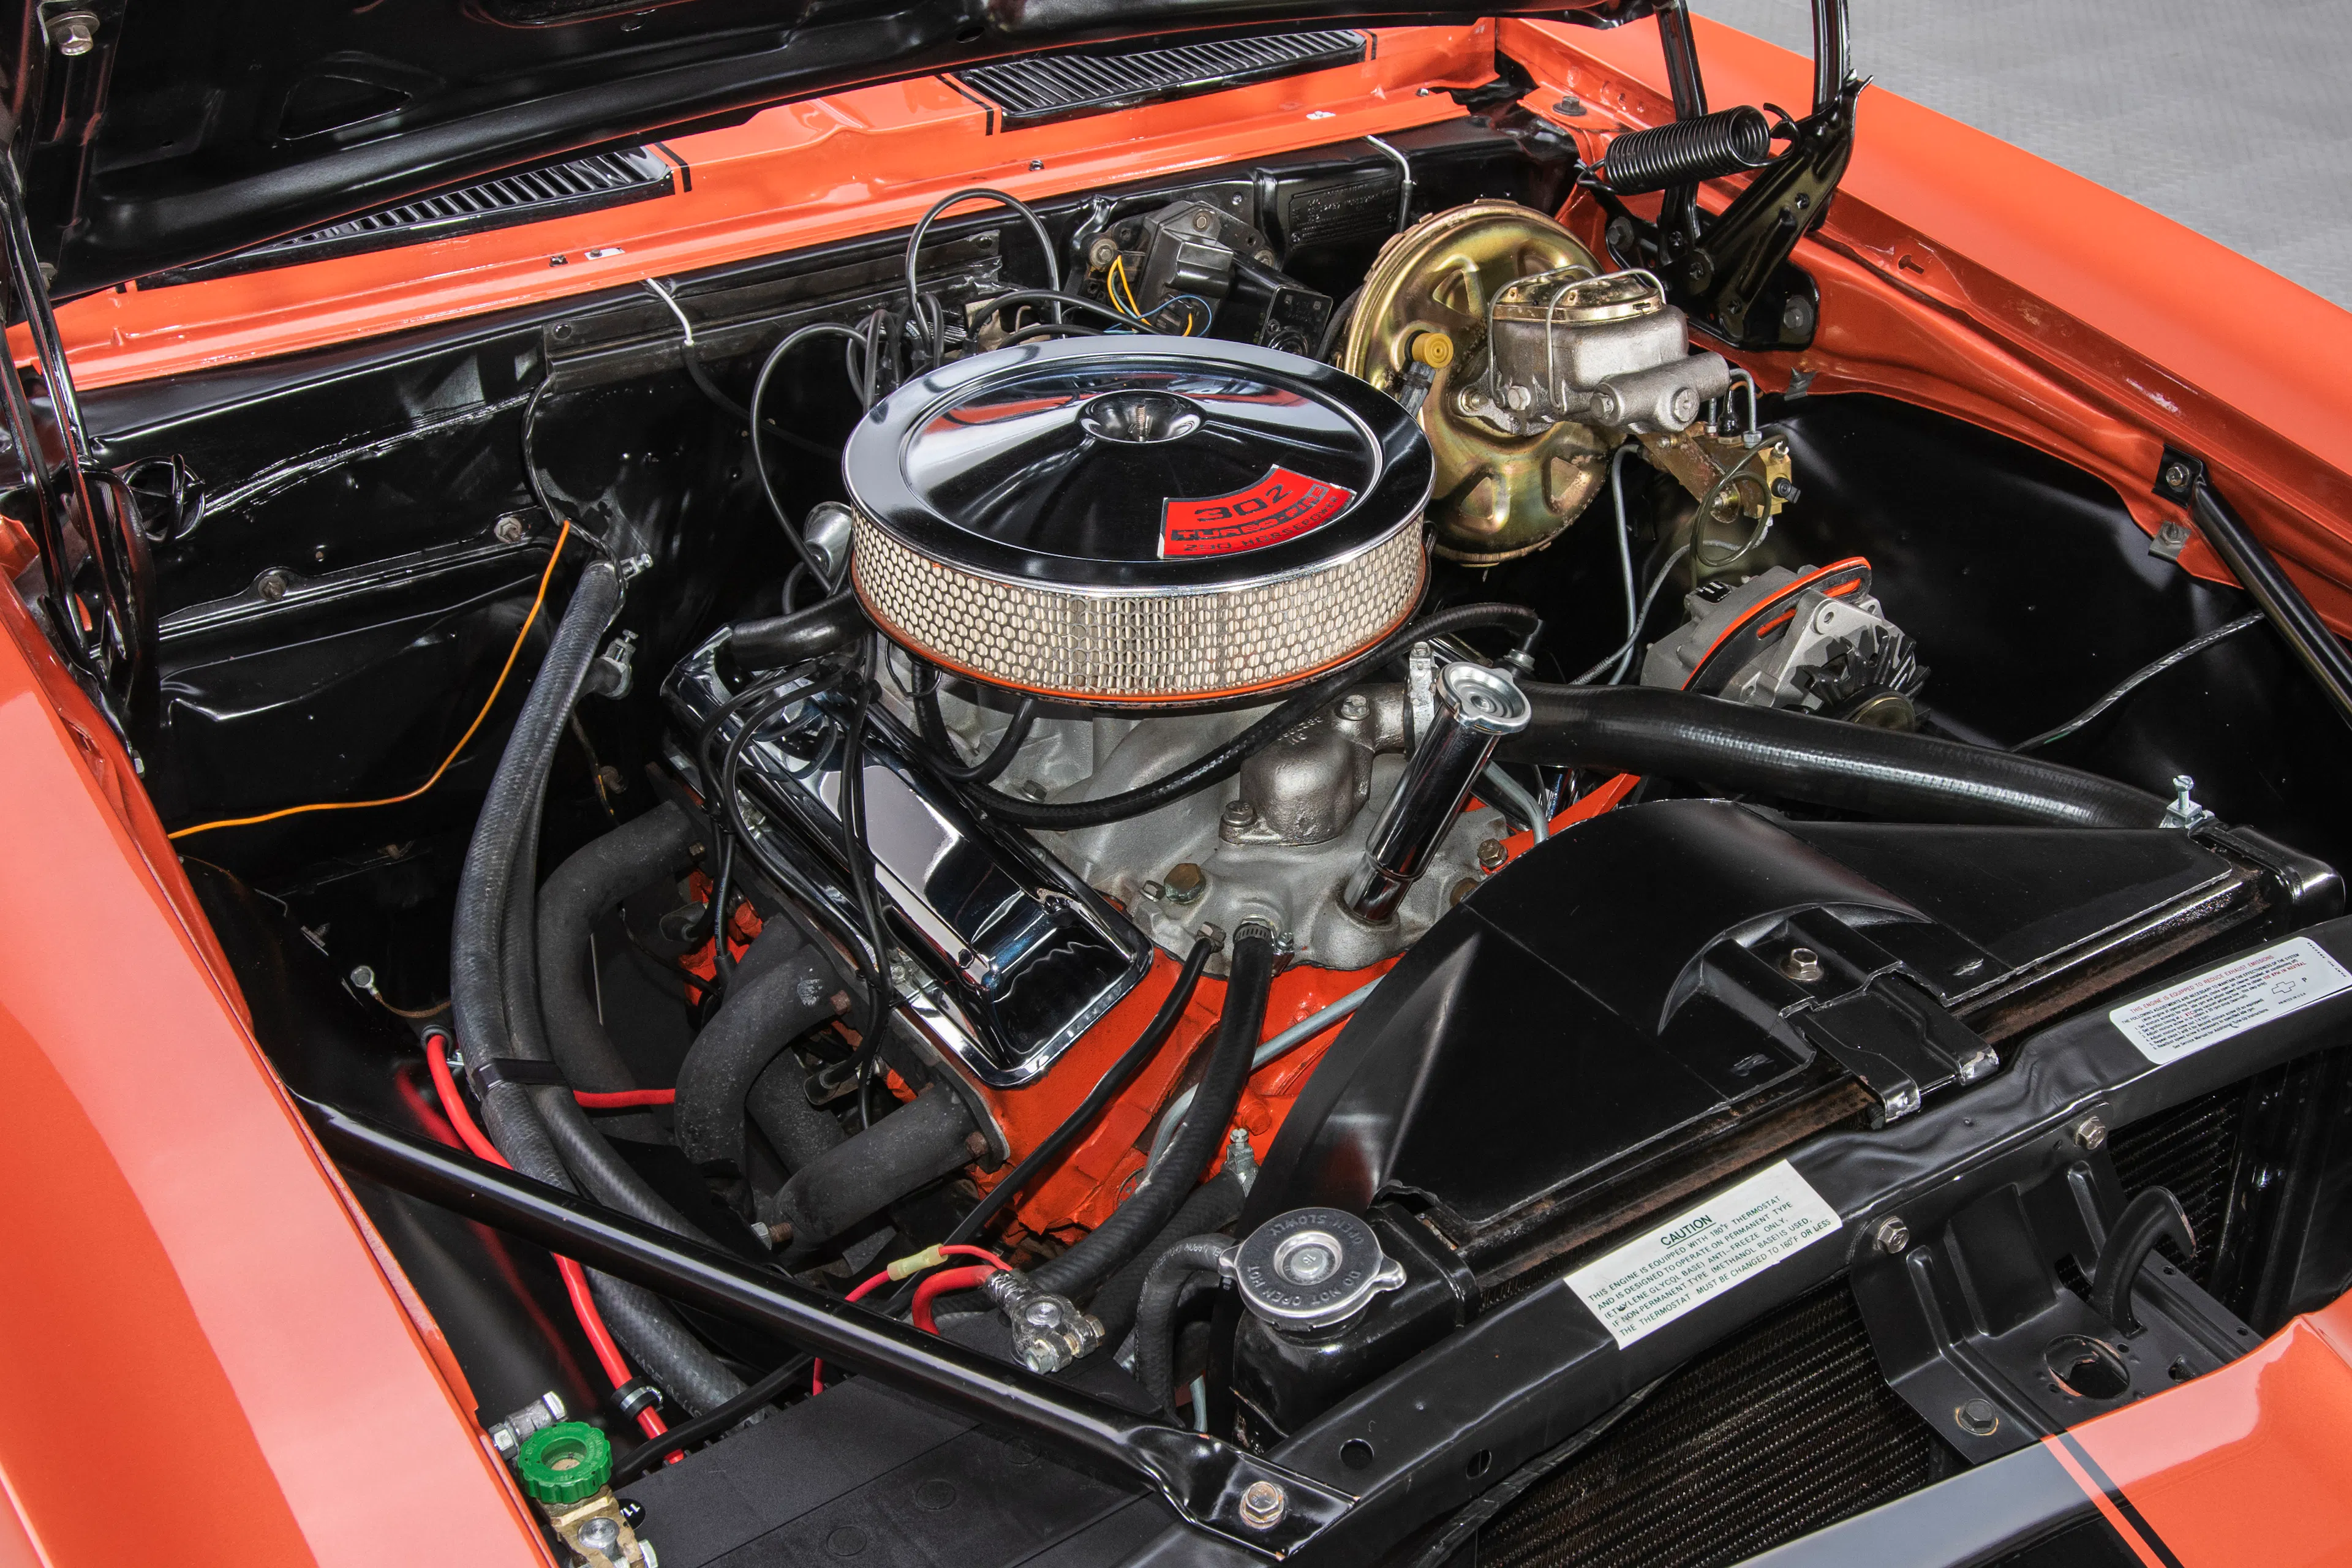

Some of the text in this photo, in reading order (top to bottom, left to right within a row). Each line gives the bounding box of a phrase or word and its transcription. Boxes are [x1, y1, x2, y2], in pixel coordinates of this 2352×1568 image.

[1183, 496, 1339, 551] 290 HORSEPOWER
[1194, 484, 1294, 522] 302
[2143, 998, 2163, 1008] ENGINE
[2169, 985, 2195, 998] EQUIPPED
[2203, 973, 2225, 984] REDUCE
[2223, 965, 2247, 976] EXHAUST
[2247, 955, 2274, 967] EMISSIONS
[2286, 962, 2307, 971] NEUTRAL
[2130, 1009, 2154, 1021] FOLLOWING
[2154, 999, 2182, 1012] ADJUSTMENTS
[2189, 987, 2211, 998] NECESSARY
[2217, 978, 2236, 987] MAINTAIN
[2242, 963, 2272, 977] EFFECTIVENESS
[1268, 1215, 1365, 1245] OPEN SLOWLY
[1588, 1288, 1608, 1301] THIS
[1608, 1271, 1639, 1291] ENGINE
[1648, 1246, 1686, 1270] EQUIPPED
[1687, 1235, 1708, 1248] WITH
[1709, 1223, 1728, 1237] 180°F
[1731, 1195, 1780, 1225] THERMOSTAT
[1660, 1215, 1713, 1246] CAUTION
[1681, 1261, 1705, 1276] BASE)
[1708, 1232, 1760, 1264] ANTI-FREEZE
[1763, 1217, 1788, 1232] ONLY.
[1687, 1271, 1708, 1285] TYPE
[1711, 1248, 1757, 1273] (METHANOL
[1757, 1233, 1780, 1248] BASE)
[1788, 1218, 1812, 1231] USED,
[1248, 1265, 1265, 1287] HOT
[1344, 1270, 1362, 1286] DO
[1597, 1297, 1615, 1311] AND
[1624, 1270, 1664, 1295] DESIGNED
[1663, 1264, 1676, 1273] TO
[1675, 1246, 1711, 1267] OPERATE
[1711, 1239, 1724, 1249] ON
[1724, 1213, 1770, 1242] PERMANENT
[1772, 1201, 1793, 1215] TYPE
[1619, 1219, 1831, 1336] THE THERMOSTAT MUST BE CHANGED TO 160°F OR LESS
[1262, 1287, 1302, 1306] OPEN
[1311, 1286, 1343, 1305] NOT
